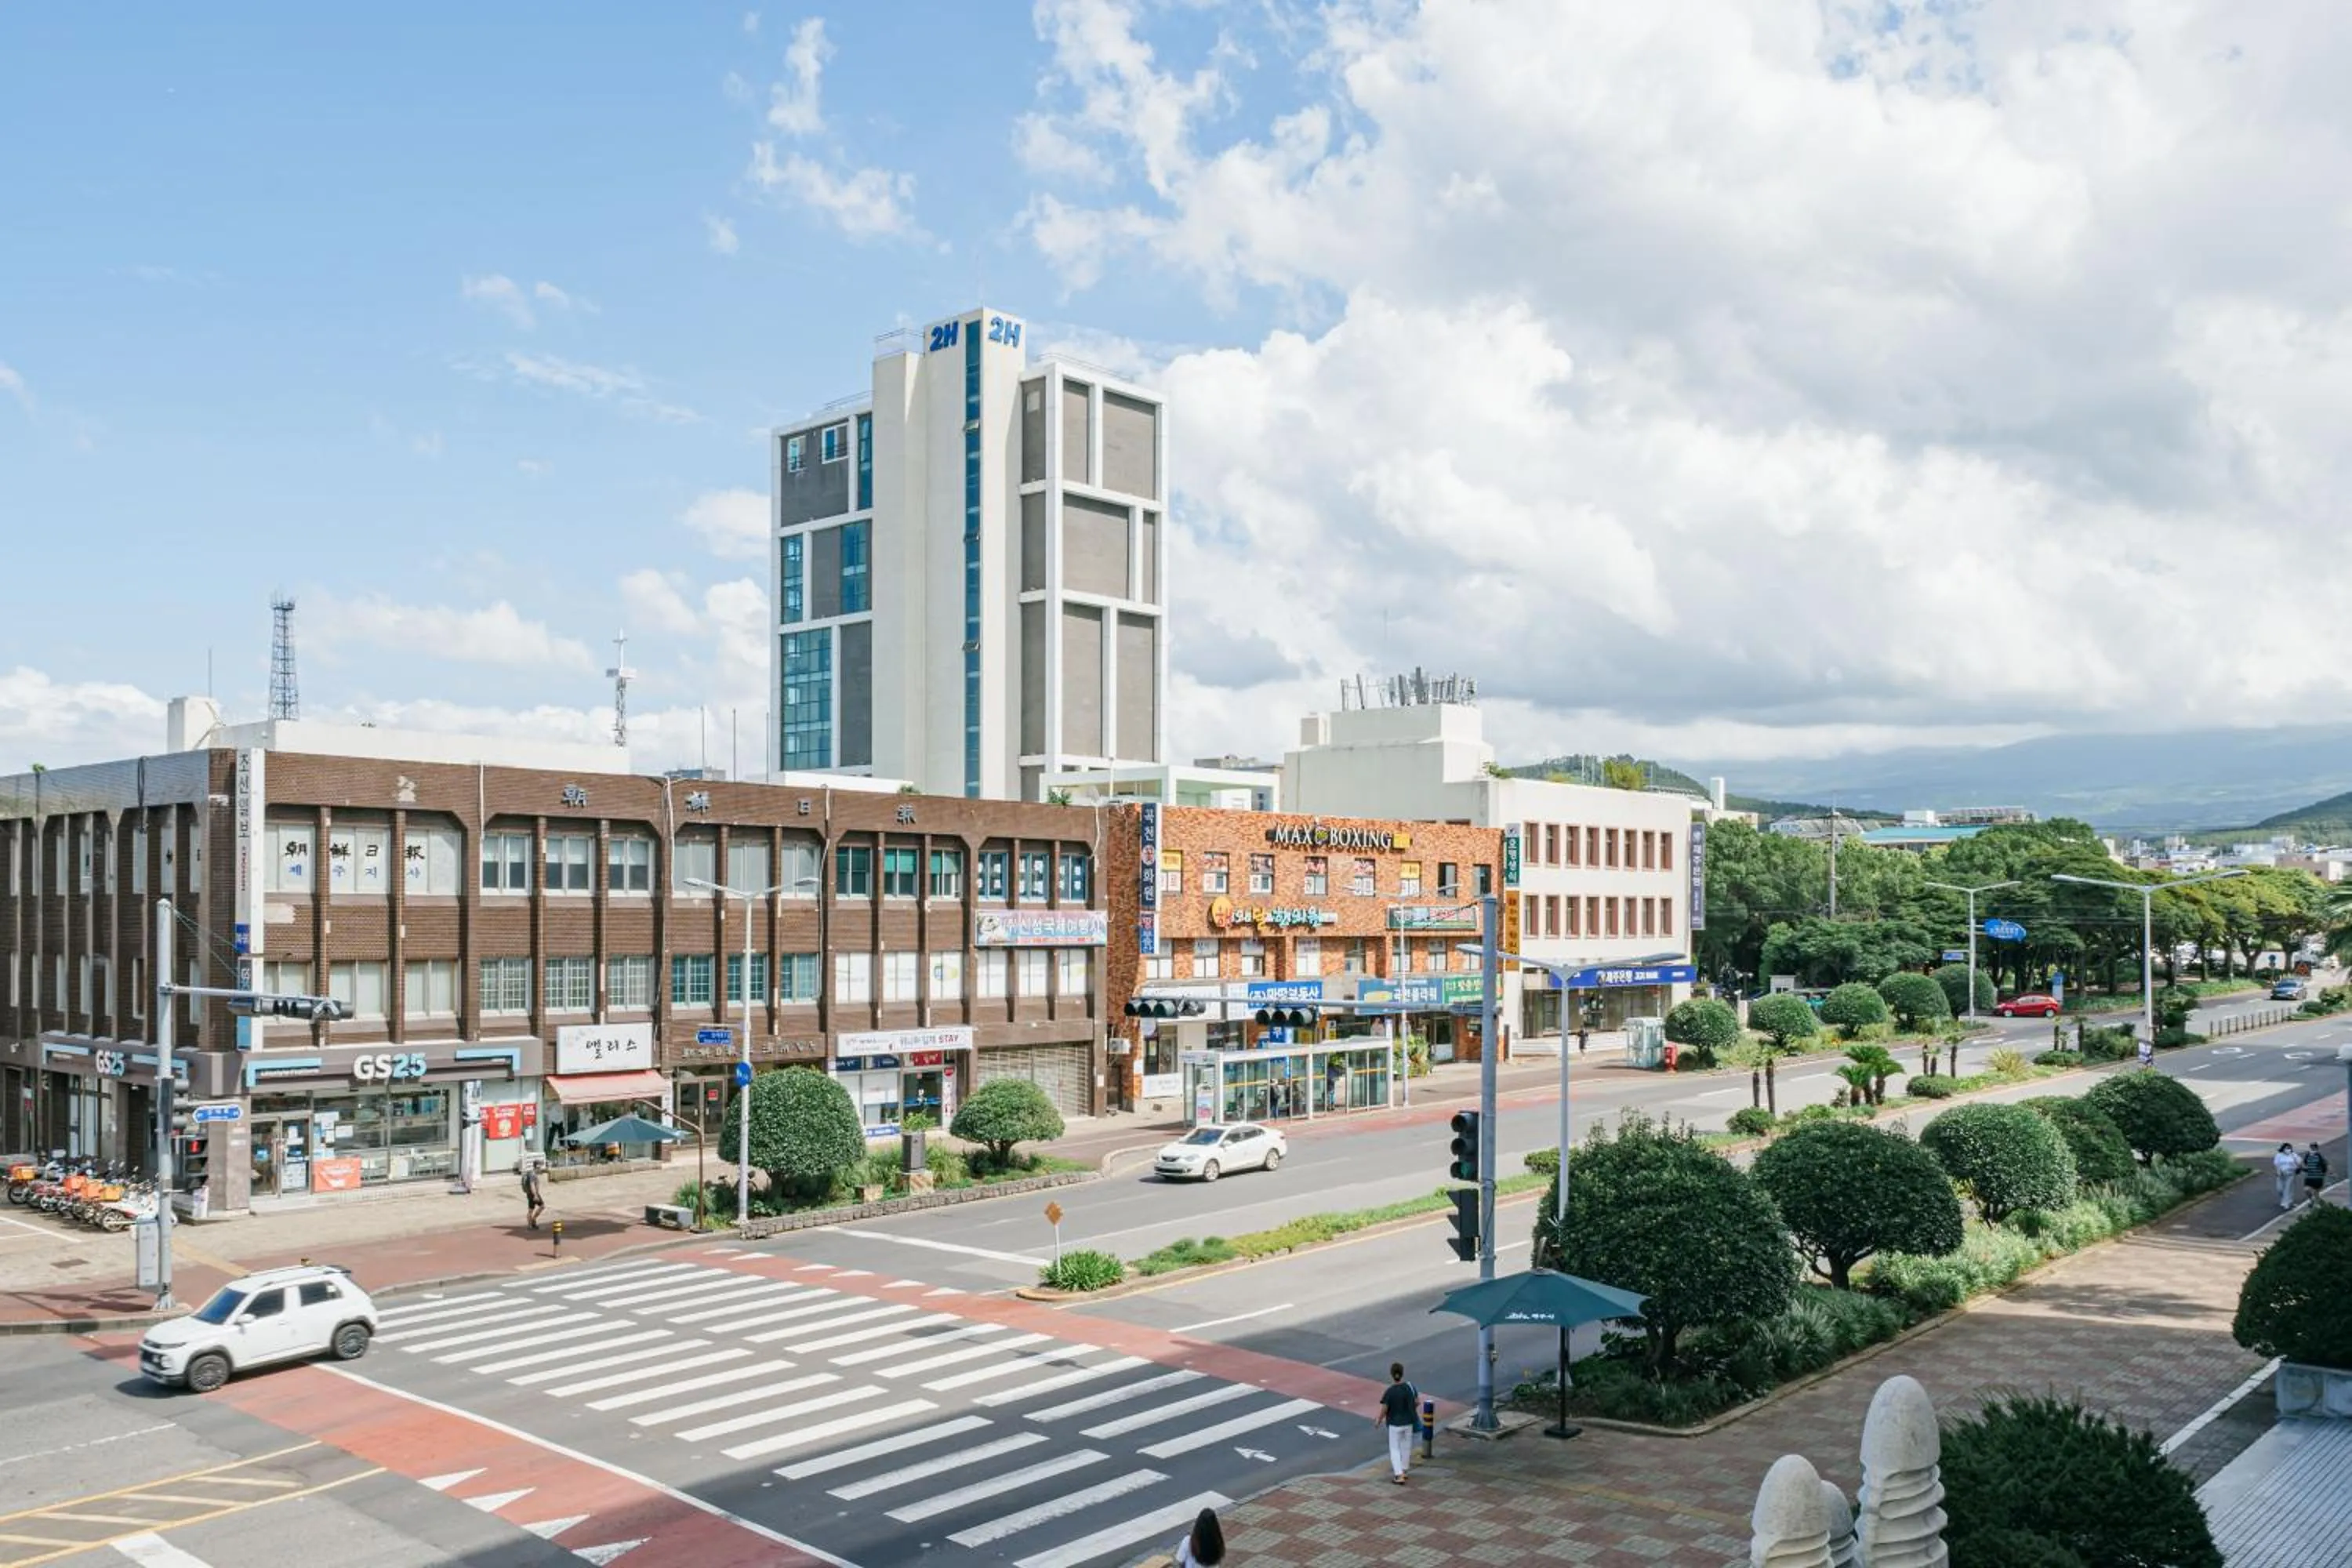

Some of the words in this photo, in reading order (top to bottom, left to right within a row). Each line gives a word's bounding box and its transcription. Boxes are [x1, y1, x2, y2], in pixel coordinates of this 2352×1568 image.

[930, 321, 958, 351] 2H
[989, 316, 1022, 348] 2H
[238, 753, 250, 838] 조선일보
[1275, 824, 1312, 844] MAX
[1329, 827, 1392, 849] BOXING
[96, 1049, 125, 1076] GS25
[354, 1052, 427, 1080] GS25
